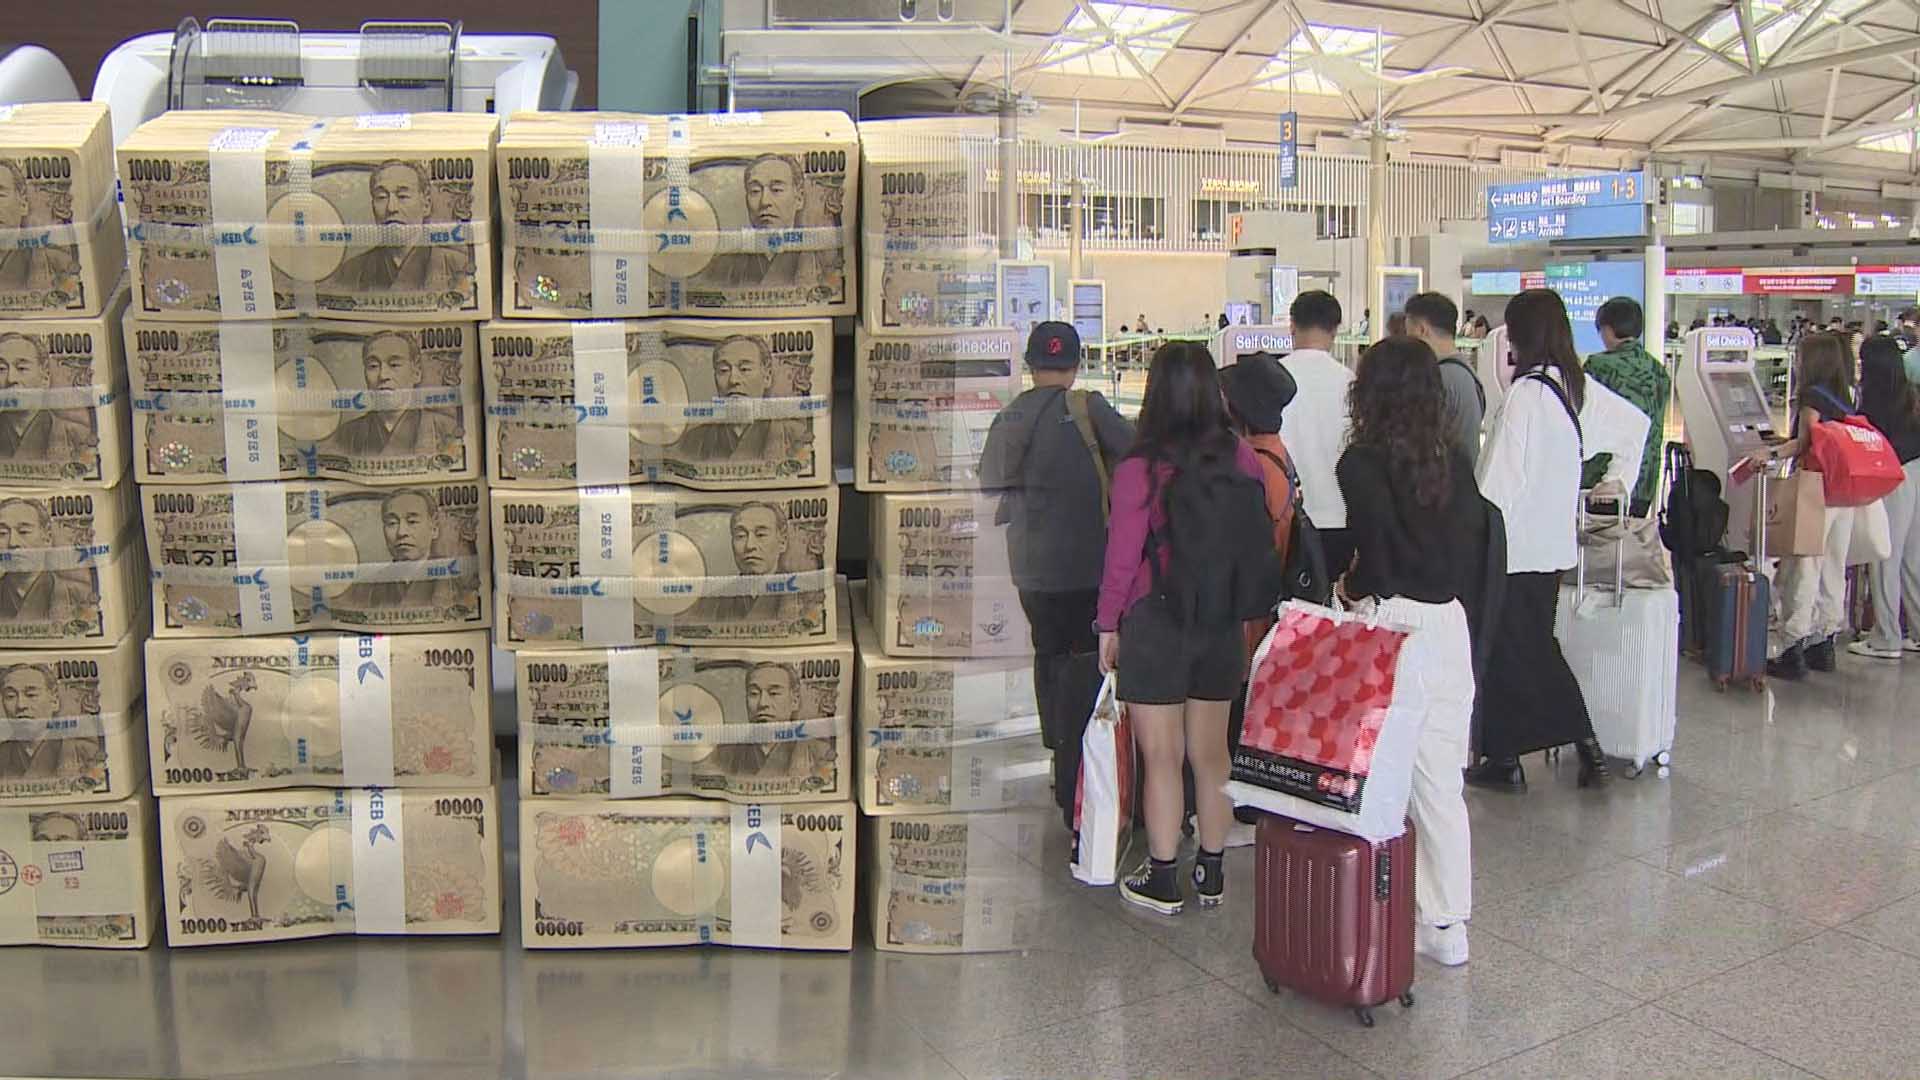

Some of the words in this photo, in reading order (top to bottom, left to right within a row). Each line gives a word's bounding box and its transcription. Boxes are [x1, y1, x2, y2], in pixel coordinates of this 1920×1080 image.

[1282, 120, 1293, 141] 3
[25, 157, 71, 179] 10000
[128, 158, 171, 182] 10000
[430, 157, 474, 180] 10000
[507, 157, 550, 179] 10000
[804, 150, 846, 174] 10000
[880, 172, 926, 195] 10000
[49, 332, 93, 355] 10000
[135, 330, 179, 352] 10000
[420, 327, 463, 349] 10000
[491, 336, 534, 358] 10000
[771, 331, 815, 354] 10000
[1236, 334, 1259, 350] Self
[1706, 335, 1721, 347] Self
[50, 495, 93, 517] 10000
[153, 493, 195, 514] 10000
[438, 486, 479, 507] 10000
[503, 504, 545, 525] 10000
[787, 497, 828, 520] 10000
[899, 507, 941, 528] 10000
[358, 635, 374, 659] EB
[424, 648, 475, 667] 10000
[57, 660, 98, 680] 10000
[211, 655, 290, 668] NIPPON
[800, 658, 841, 680] 10000
[527, 663, 567, 683] 10000
[876, 671, 918, 691] 10000
[165, 767, 213, 785] 10000
[1268, 764, 1312, 783] AIRPORT
[369, 787, 384, 821] KEB
[434, 798, 484, 817] 10000
[87, 812, 129, 832] 10000
[747, 803, 761, 829] EB
[797, 814, 843, 832] 10000
[890, 822, 930, 842] 10000
[180, 917, 227, 935] 10000
[535, 921, 584, 937] 10000
